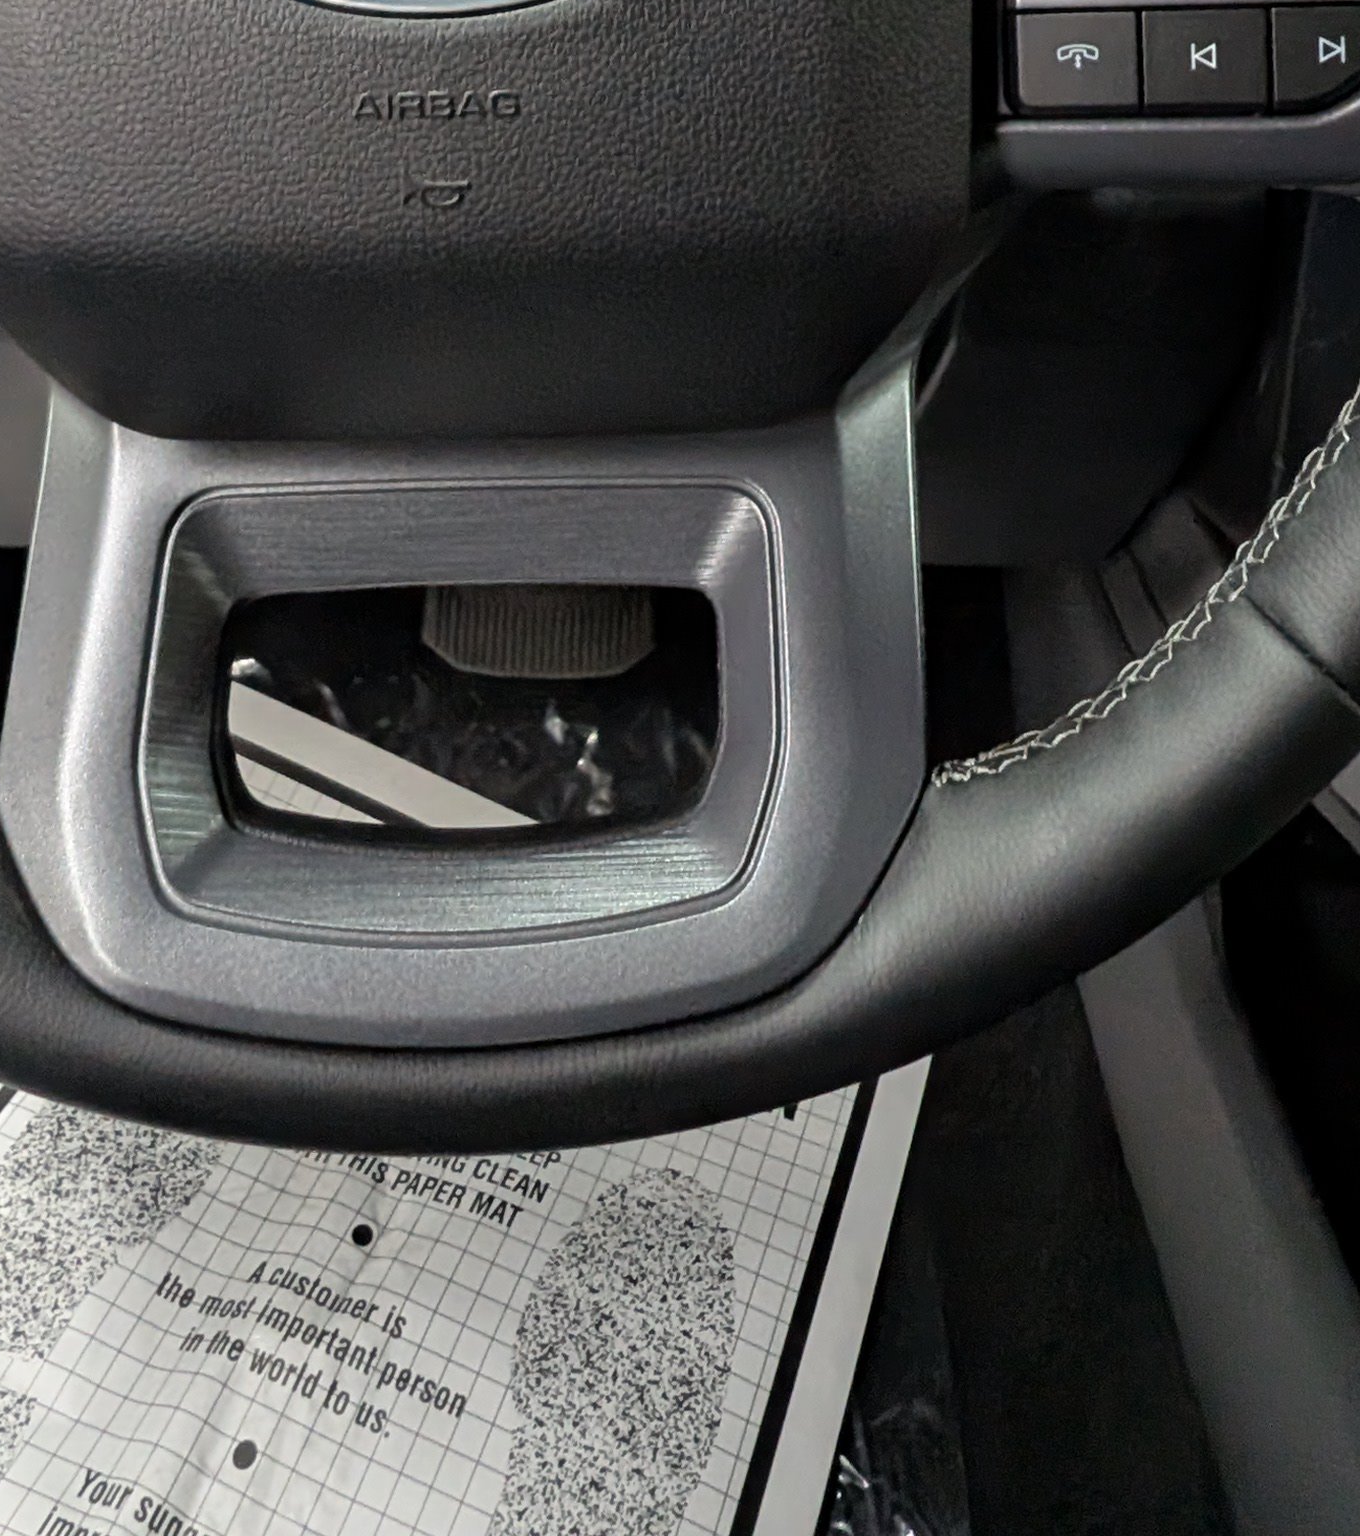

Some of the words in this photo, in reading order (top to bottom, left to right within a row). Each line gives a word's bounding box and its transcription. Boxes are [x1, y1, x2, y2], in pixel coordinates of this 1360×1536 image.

[351, 88, 523, 122] AIRBAG
[390, 1168, 467, 1210] PAPER
[468, 1192, 525, 1229] MAT
[472, 1158, 551, 1204] CLEAN
[247, 1260, 268, 1284] A
[267, 1265, 379, 1324] customer
[381, 1305, 407, 1340] is
[155, 1271, 195, 1309] the
[198, 1294, 257, 1320] most
[255, 1297, 380, 1376] important
[376, 1360, 467, 1419] person
[179, 1326, 202, 1353] in
[205, 1329, 245, 1362] the
[248, 1347, 323, 1400] world
[323, 1379, 351, 1416] to
[354, 1401, 391, 1439] us.
[76, 1467, 134, 1511] Your
